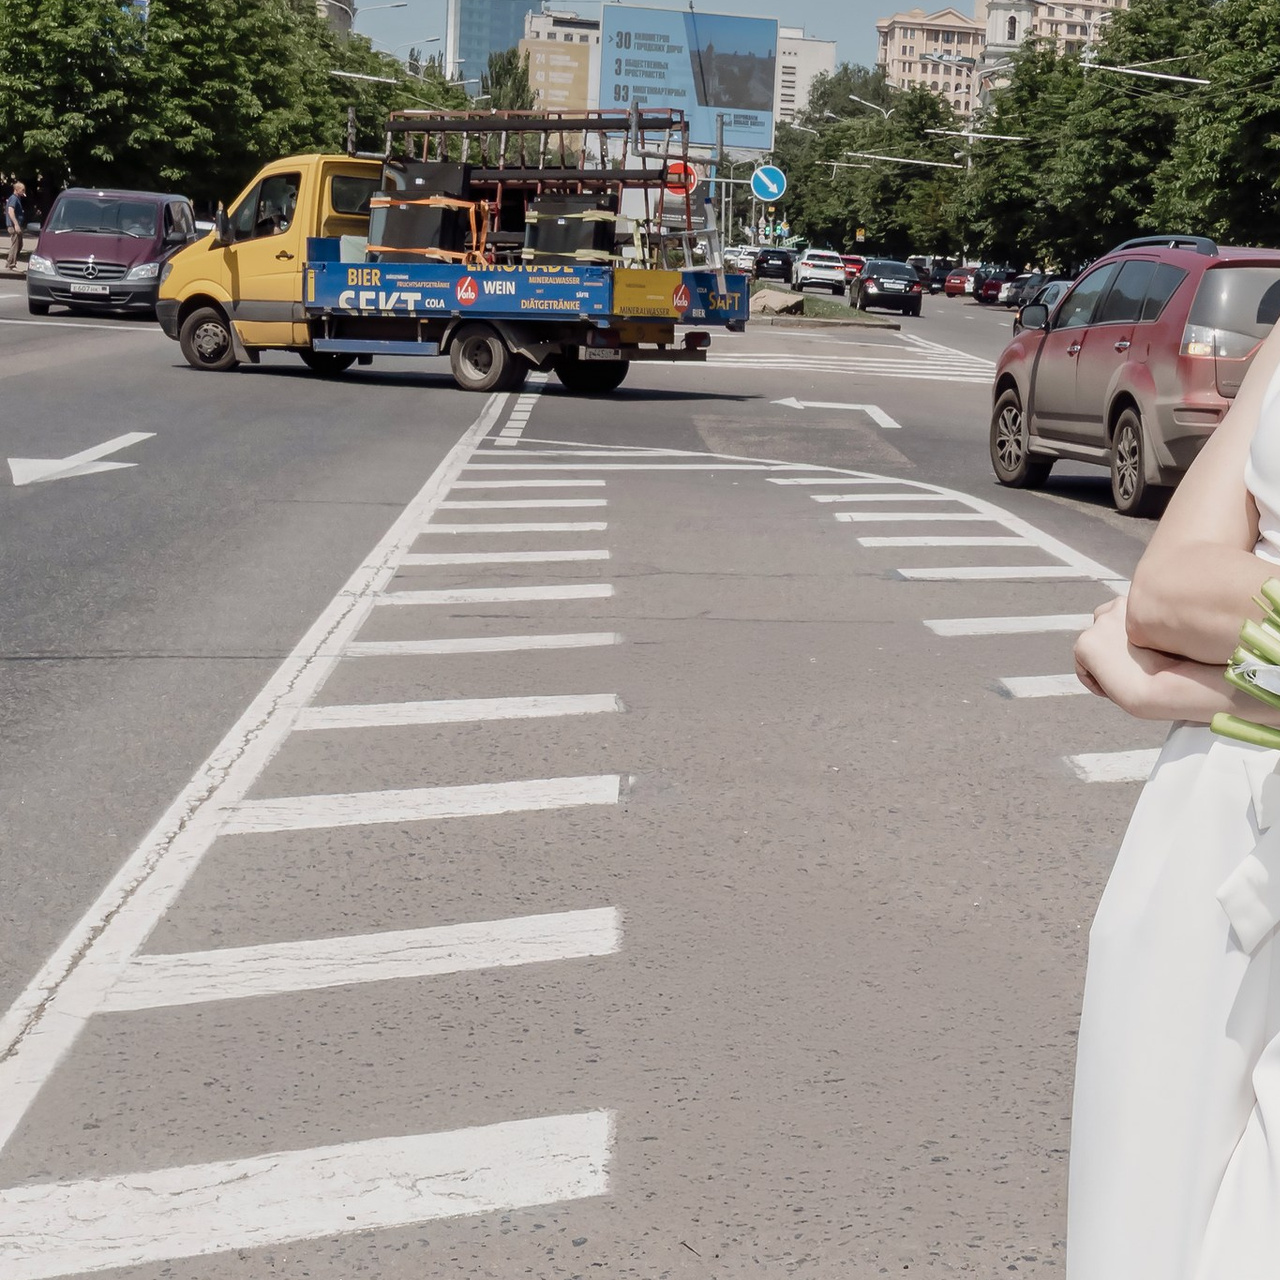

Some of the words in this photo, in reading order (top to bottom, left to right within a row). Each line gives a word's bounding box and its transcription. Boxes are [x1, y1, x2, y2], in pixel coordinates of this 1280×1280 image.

[616, 30, 632, 50] 30
[614, 58, 622, 76] 3
[614, 84, 629, 102] 93
[347, 268, 381, 286] BIER
[528, 276, 580, 285] MINERALWASSER
[483, 280, 516, 295] WEIN
[425, 298, 446, 308] COLA
[521, 298, 580, 311] DIÄTGETRÄNKE
[709, 292, 740, 310] SAFT
[620, 306, 670, 316] MINERALWASSER
[692, 308, 706, 318] BIER
